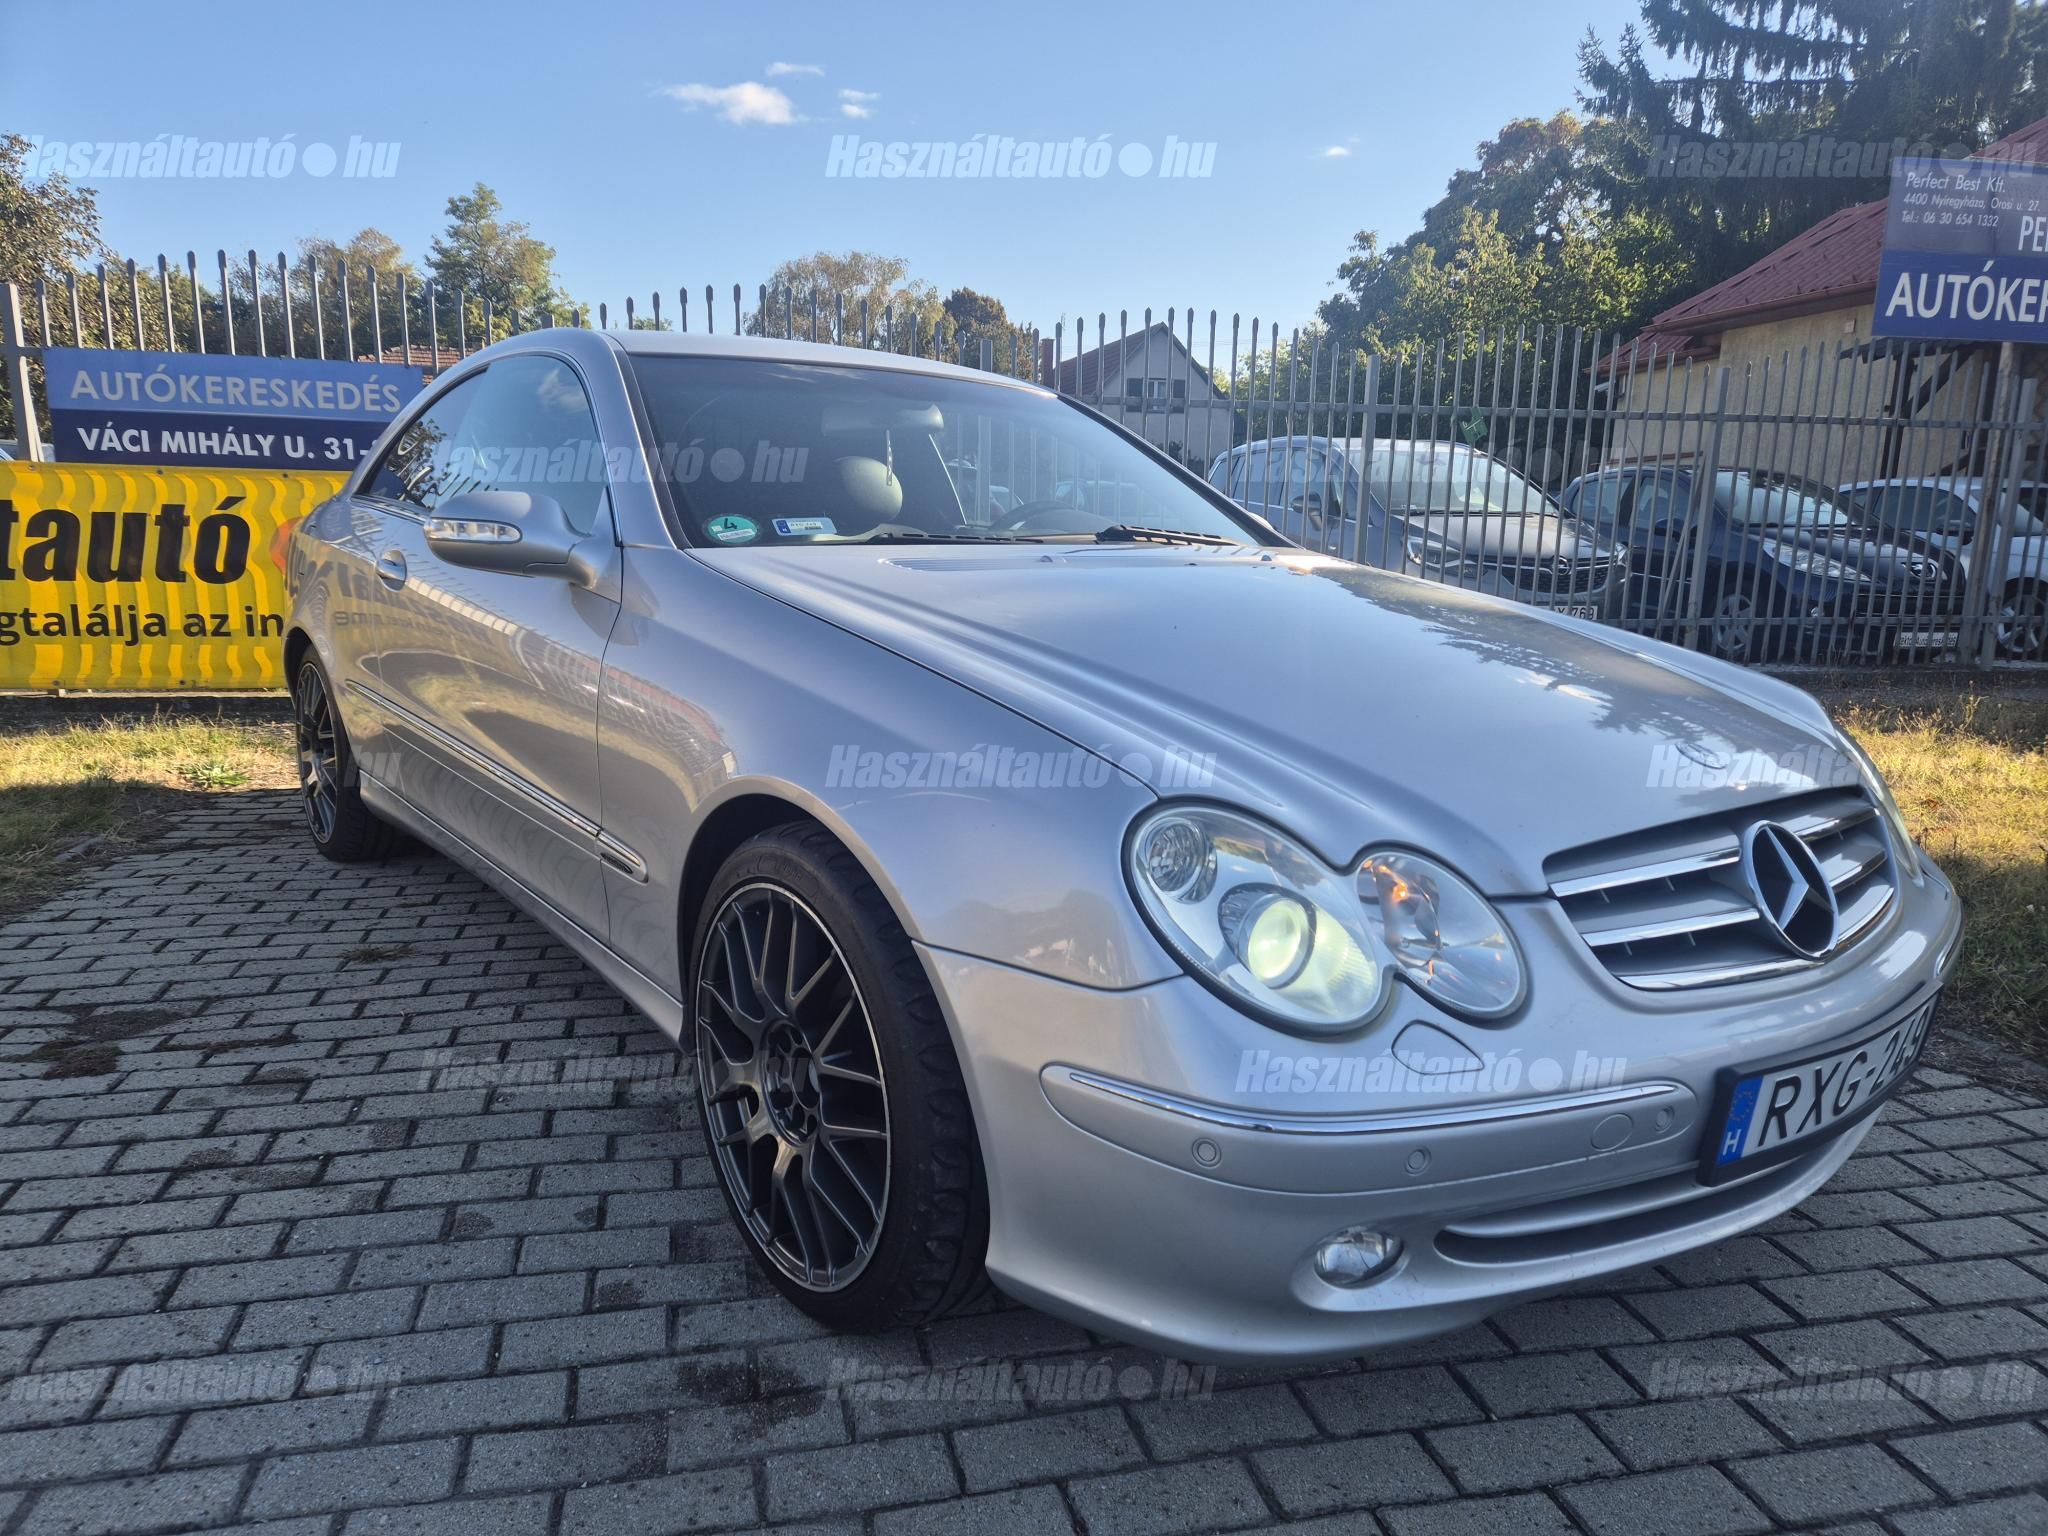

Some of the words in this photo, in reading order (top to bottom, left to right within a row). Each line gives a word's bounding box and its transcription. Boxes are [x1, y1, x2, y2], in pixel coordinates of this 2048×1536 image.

[1905, 172, 1949, 189] Perfect
[1955, 174, 1981, 191] Best
[1986, 176, 2006, 193] Kft.
[1904, 193, 1928, 206] 4400
[1923, 211, 1936, 224] 06
[1939, 212, 1952, 225] 30
[1955, 213, 1973, 225] 654
[1977, 214, 1999, 227] 1332
[2018, 216, 2048, 252] PE
[71, 364, 402, 413] AUTÓKERESKEDÉS
[77, 422, 150, 453] VÁCI
[161, 426, 275, 457] MIHÁLY
[284, 436, 315, 460] U.
[323, 437, 377, 460] 31-
[183, 612, 231, 637] az
[1722, 1129, 1742, 1156] H
